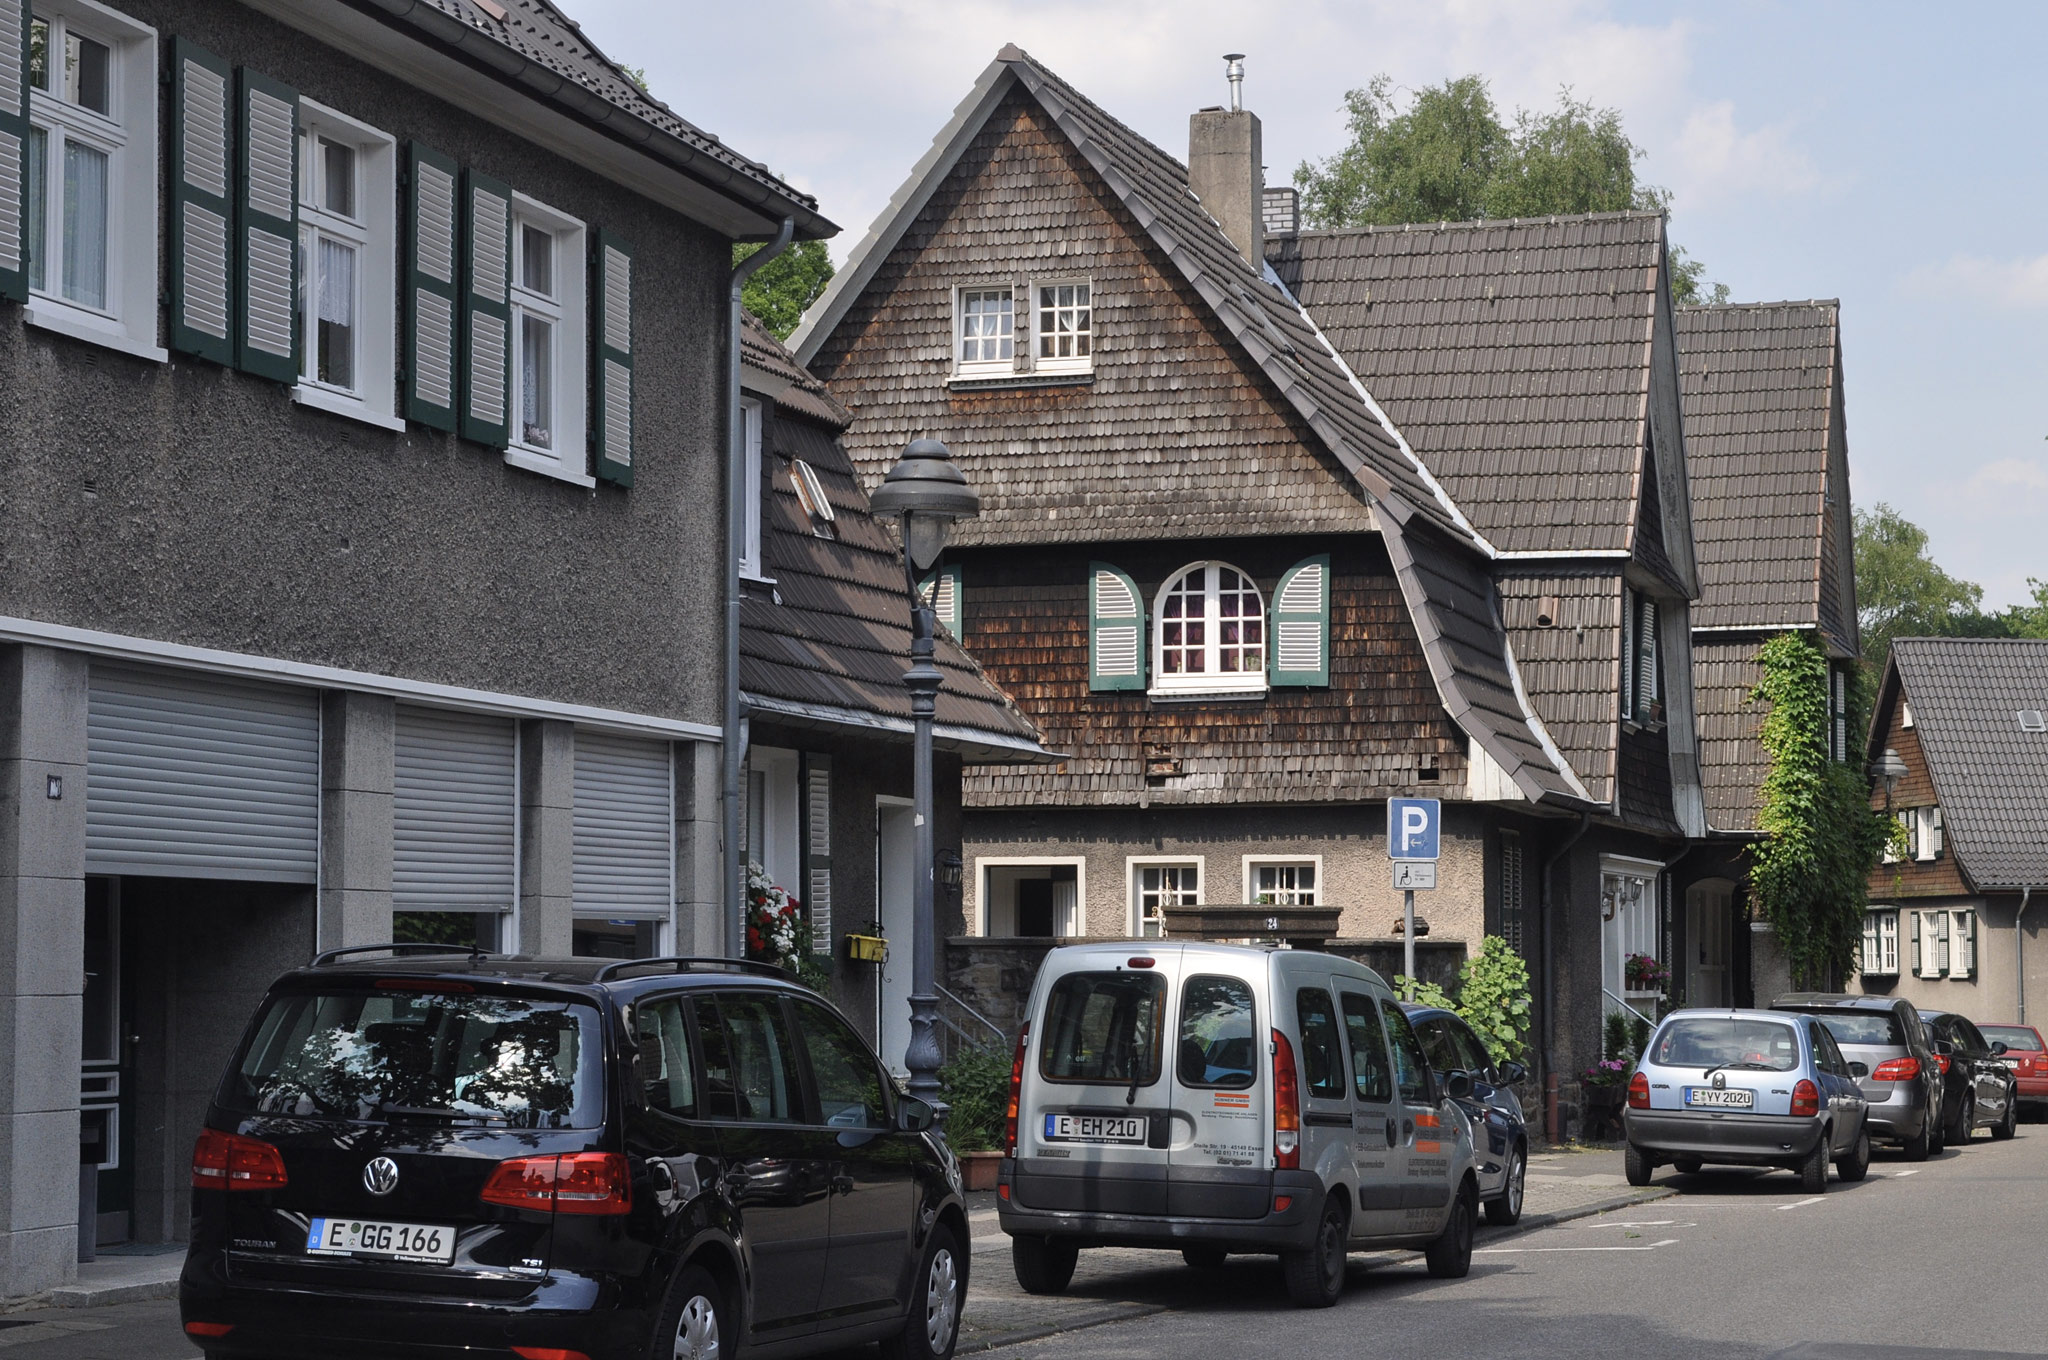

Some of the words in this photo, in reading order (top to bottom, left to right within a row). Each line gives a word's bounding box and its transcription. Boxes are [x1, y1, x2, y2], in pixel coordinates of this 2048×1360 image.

[1402, 806, 1428, 851] P
[1268, 917, 1277, 929] 24
[1692, 1090, 1700, 1102] E
[1707, 1091, 1721, 1102] YY
[1723, 1092, 1751, 1104] 2020
[1060, 1117, 1071, 1134] E
[1081, 1118, 1103, 1136] EH
[1106, 1119, 1137, 1137] 210
[1036, 1148, 1071, 1158] RENAULT
[233, 1238, 277, 1249] TOURAN
[329, 1222, 346, 1247] E
[360, 1224, 393, 1250] GG
[396, 1227, 442, 1253] 166
[521, 1258, 543, 1267] TSI
